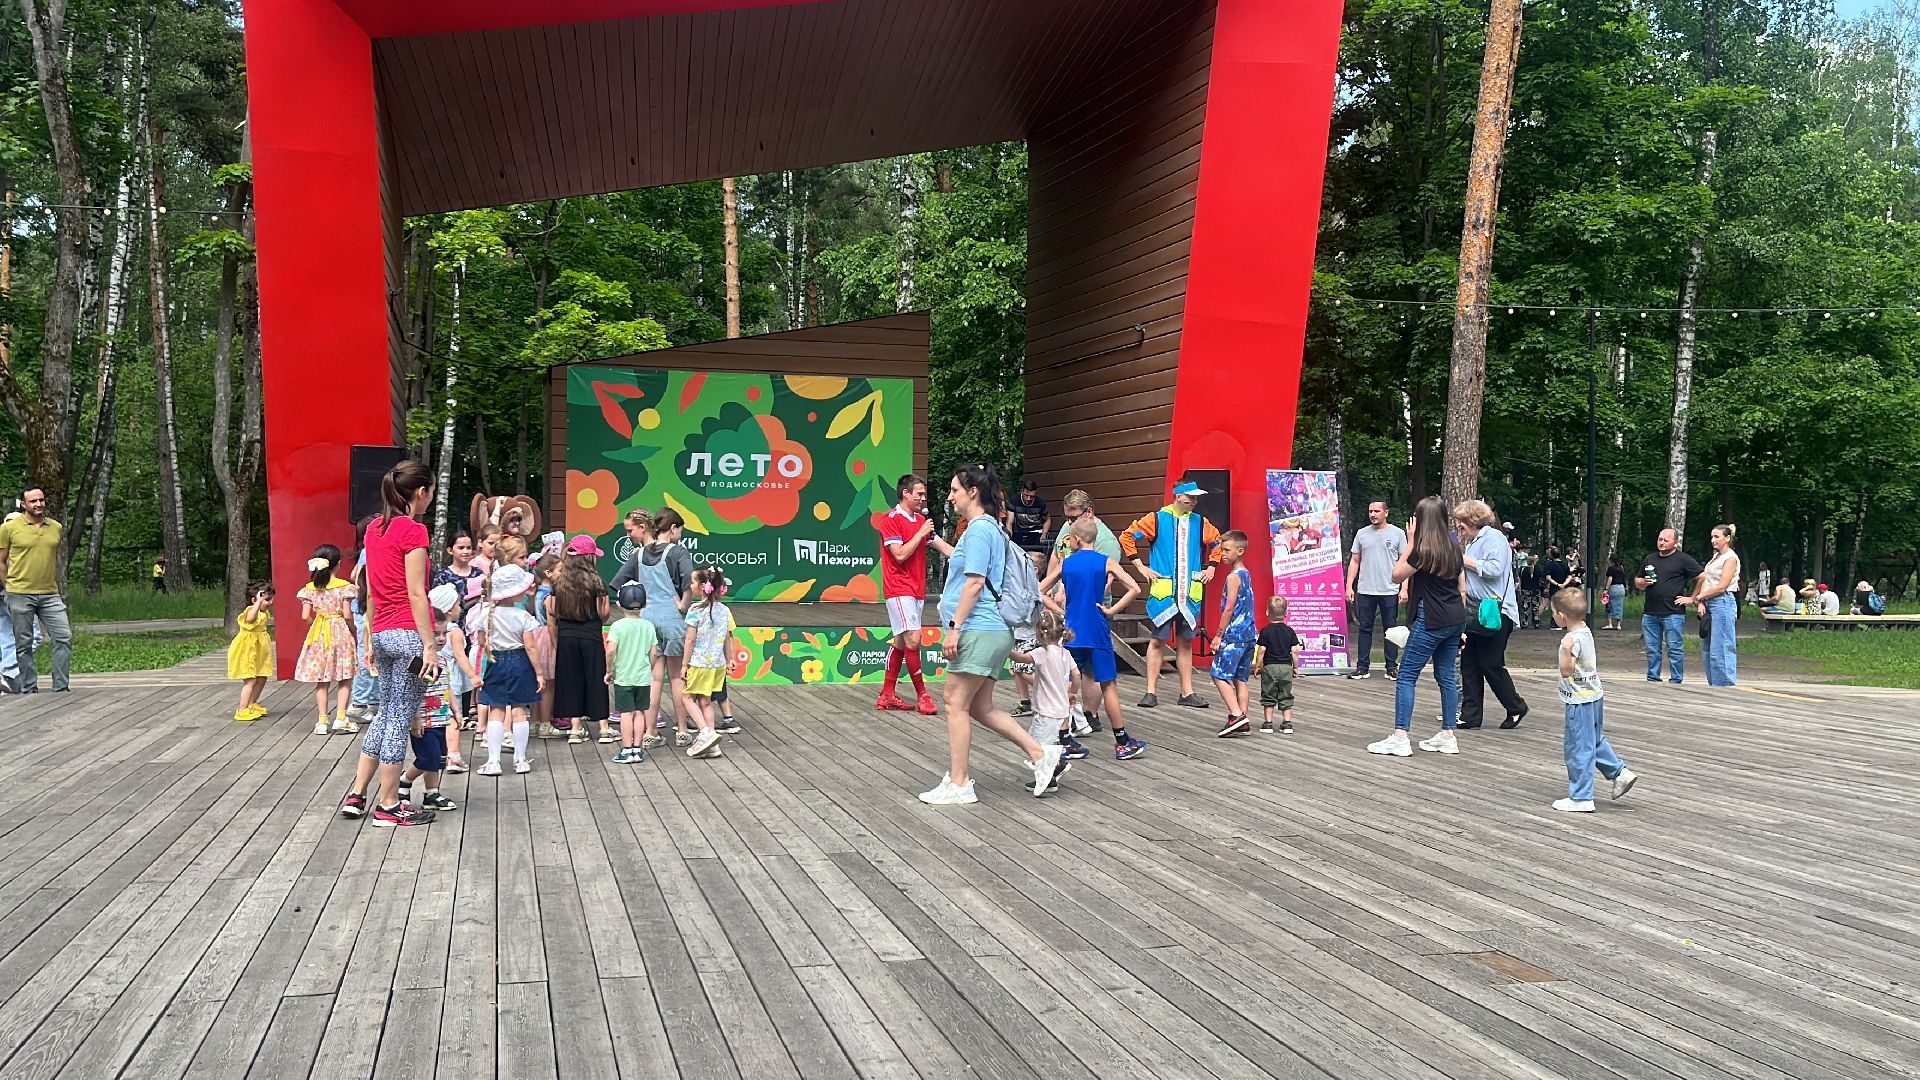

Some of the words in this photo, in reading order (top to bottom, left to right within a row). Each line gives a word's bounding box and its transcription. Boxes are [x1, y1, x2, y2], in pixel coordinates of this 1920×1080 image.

[711, 481, 790, 489] ПОДМОСКОВЬЕ
[818, 540, 851, 555] Парк
[689, 552, 767, 565] ОСКОВЬЯ
[818, 554, 874, 567] Пехорка
